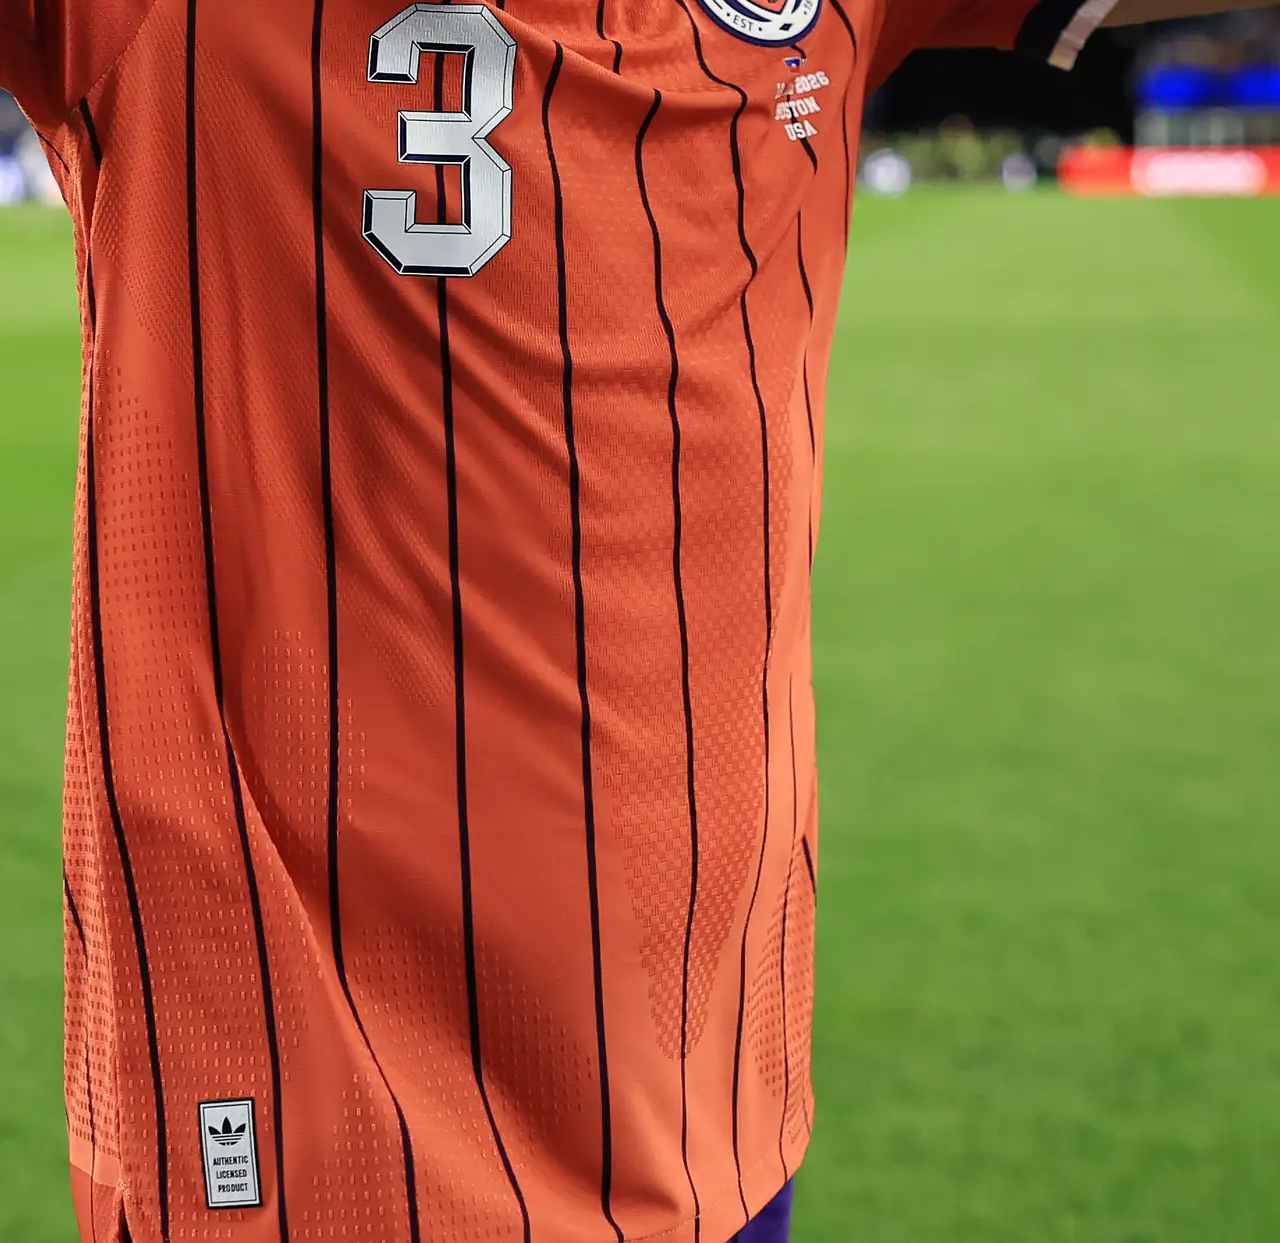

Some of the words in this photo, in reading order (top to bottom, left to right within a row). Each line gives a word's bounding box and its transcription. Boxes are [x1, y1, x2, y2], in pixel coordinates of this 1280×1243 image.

[732, 14, 754, 32] EST
[795, 70, 830, 94] 2026
[784, 119, 818, 141] USA
[362, 2, 517, 277] 3
[213, 1155, 249, 1166] AUTHENTIC
[216, 1169, 247, 1179] LICENSED
[218, 1183, 248, 1193] PRODUCT
